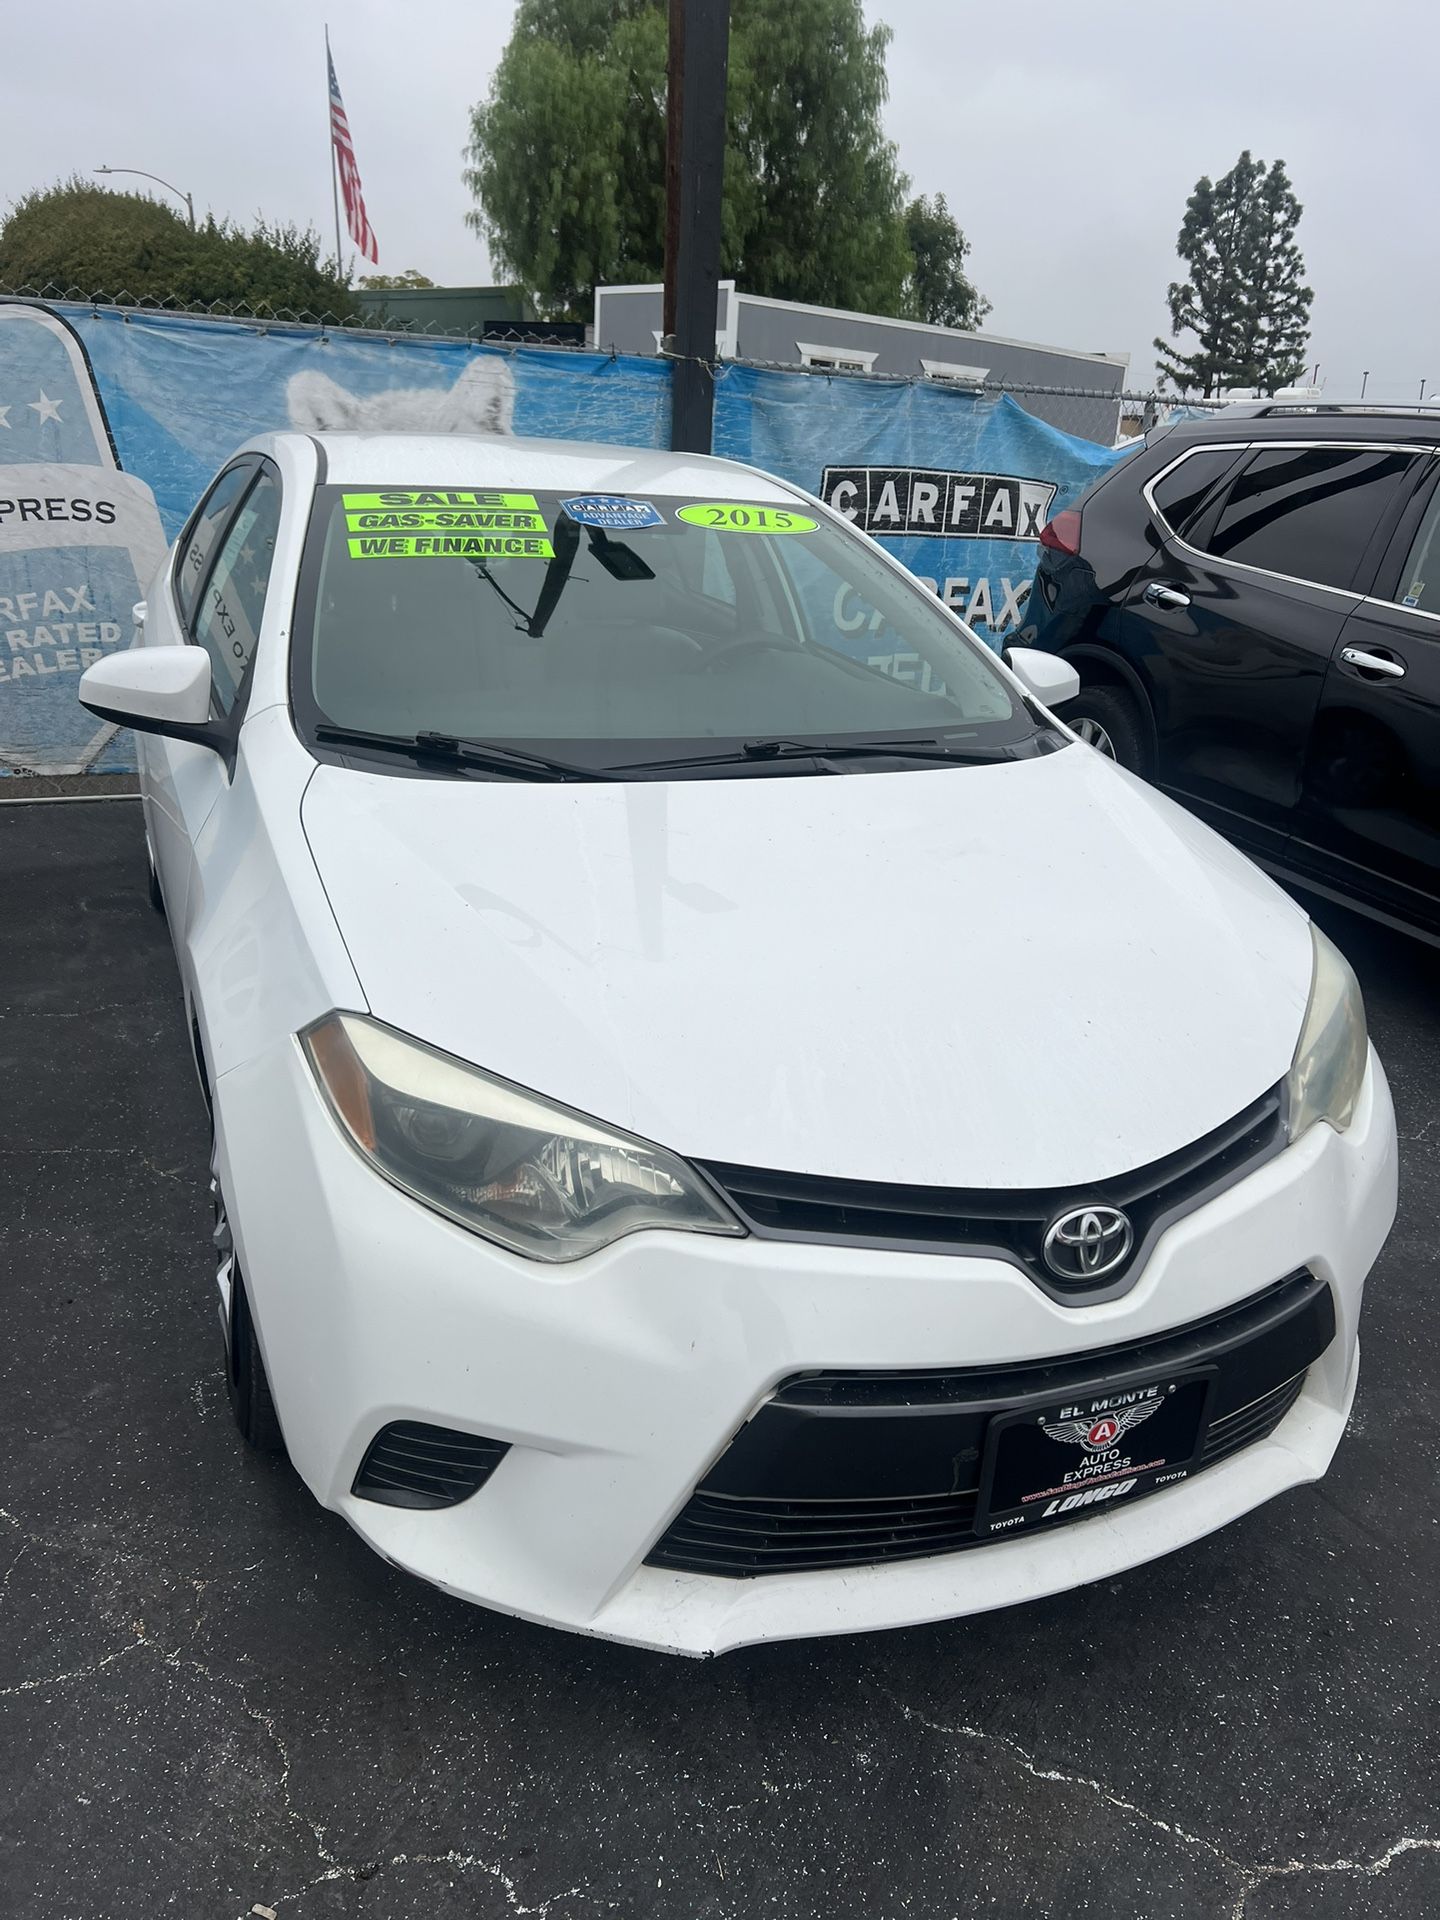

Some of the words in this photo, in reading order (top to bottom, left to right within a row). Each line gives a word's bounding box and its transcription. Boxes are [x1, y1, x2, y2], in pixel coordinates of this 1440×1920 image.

[379, 493, 507, 507] SALE
[572, 504, 651, 513] CARFAX
[830, 480, 1041, 537] CARFAX
[358, 514, 537, 529] GAS-SAVER
[582, 512, 651, 520] ADVANTAGE
[597, 518, 643, 526] DEALER
[706, 508, 793, 528] 2015
[359, 538, 409, 555] WE
[414, 538, 544, 555] FINANCE
[5, 622, 122, 651] RATED
[1059, 1407, 1084, 1419] EL
[1090, 1385, 1160, 1412] MONTE
[1094, 1423, 1112, 1441] A
[1079, 1449, 1120, 1468] AUTO
[1063, 1457, 1132, 1483] EXPRESS
[989, 1515, 1025, 1531] TOYOTA
[1041, 1478, 1138, 1518] LONGO
[1155, 1470, 1187, 1484] TOYOTA
